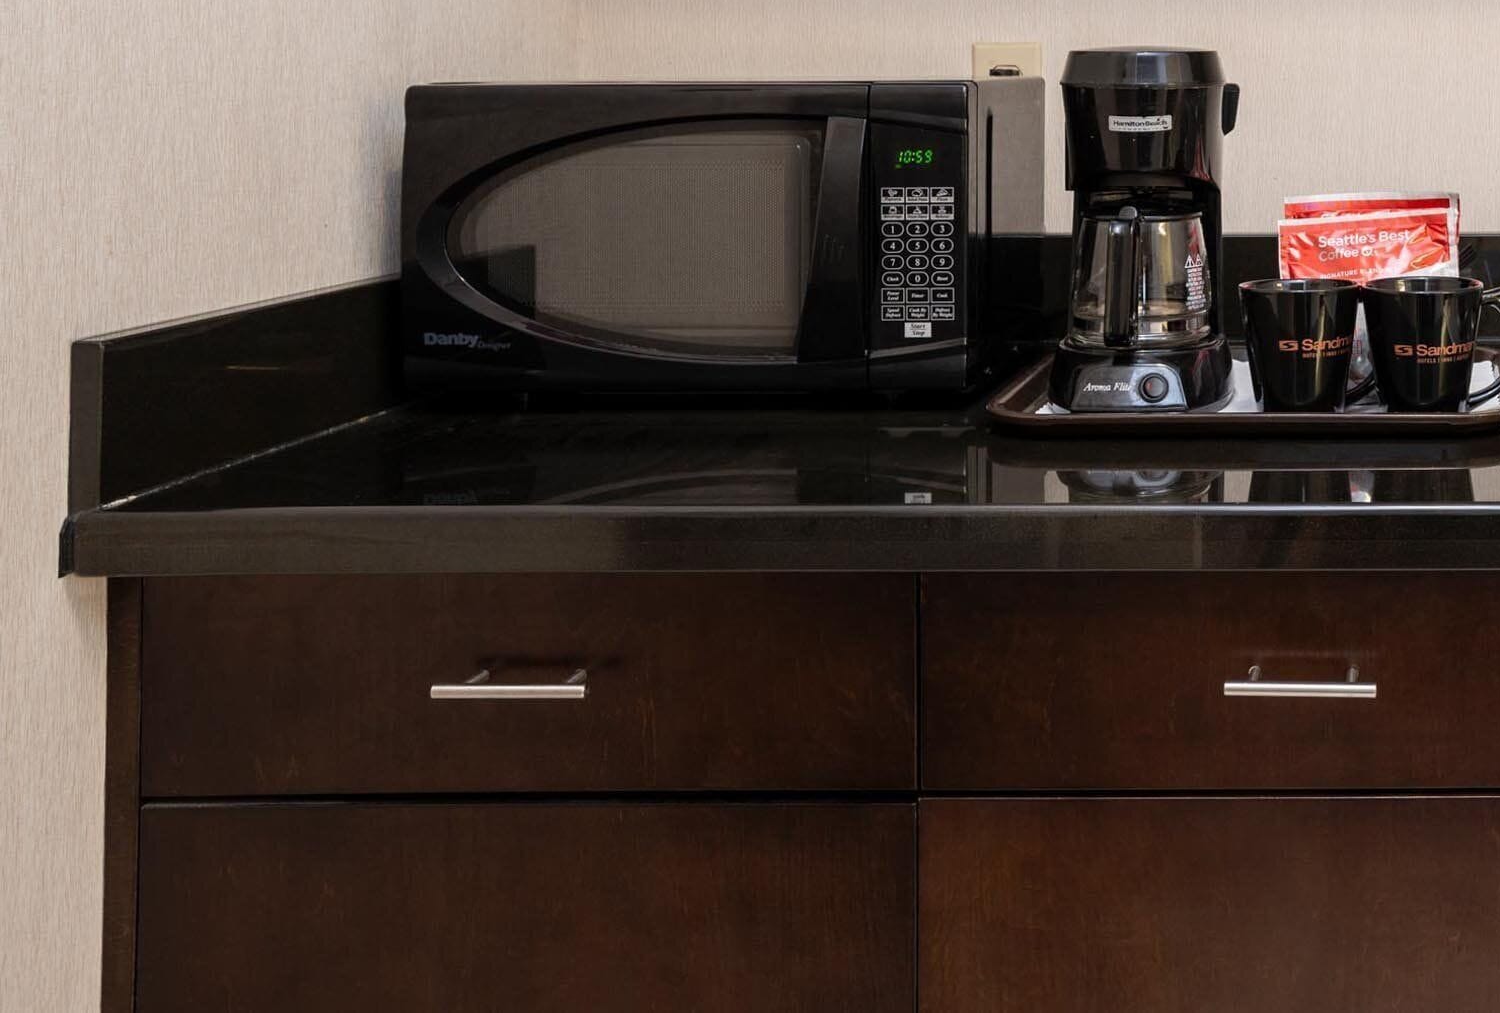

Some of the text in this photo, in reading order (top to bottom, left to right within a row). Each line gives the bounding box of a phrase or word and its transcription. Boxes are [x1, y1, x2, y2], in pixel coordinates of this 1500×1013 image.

[899, 150, 932, 163] 10:59
[1318, 229, 1410, 248] Seattle's Best
[1318, 247, 1359, 262] Coffee
[914, 274, 921, 283] 0
[424, 332, 479, 348] Danby
[1301, 336, 1351, 351] Sandm
[1083, 382, 1111, 392] Aroma
